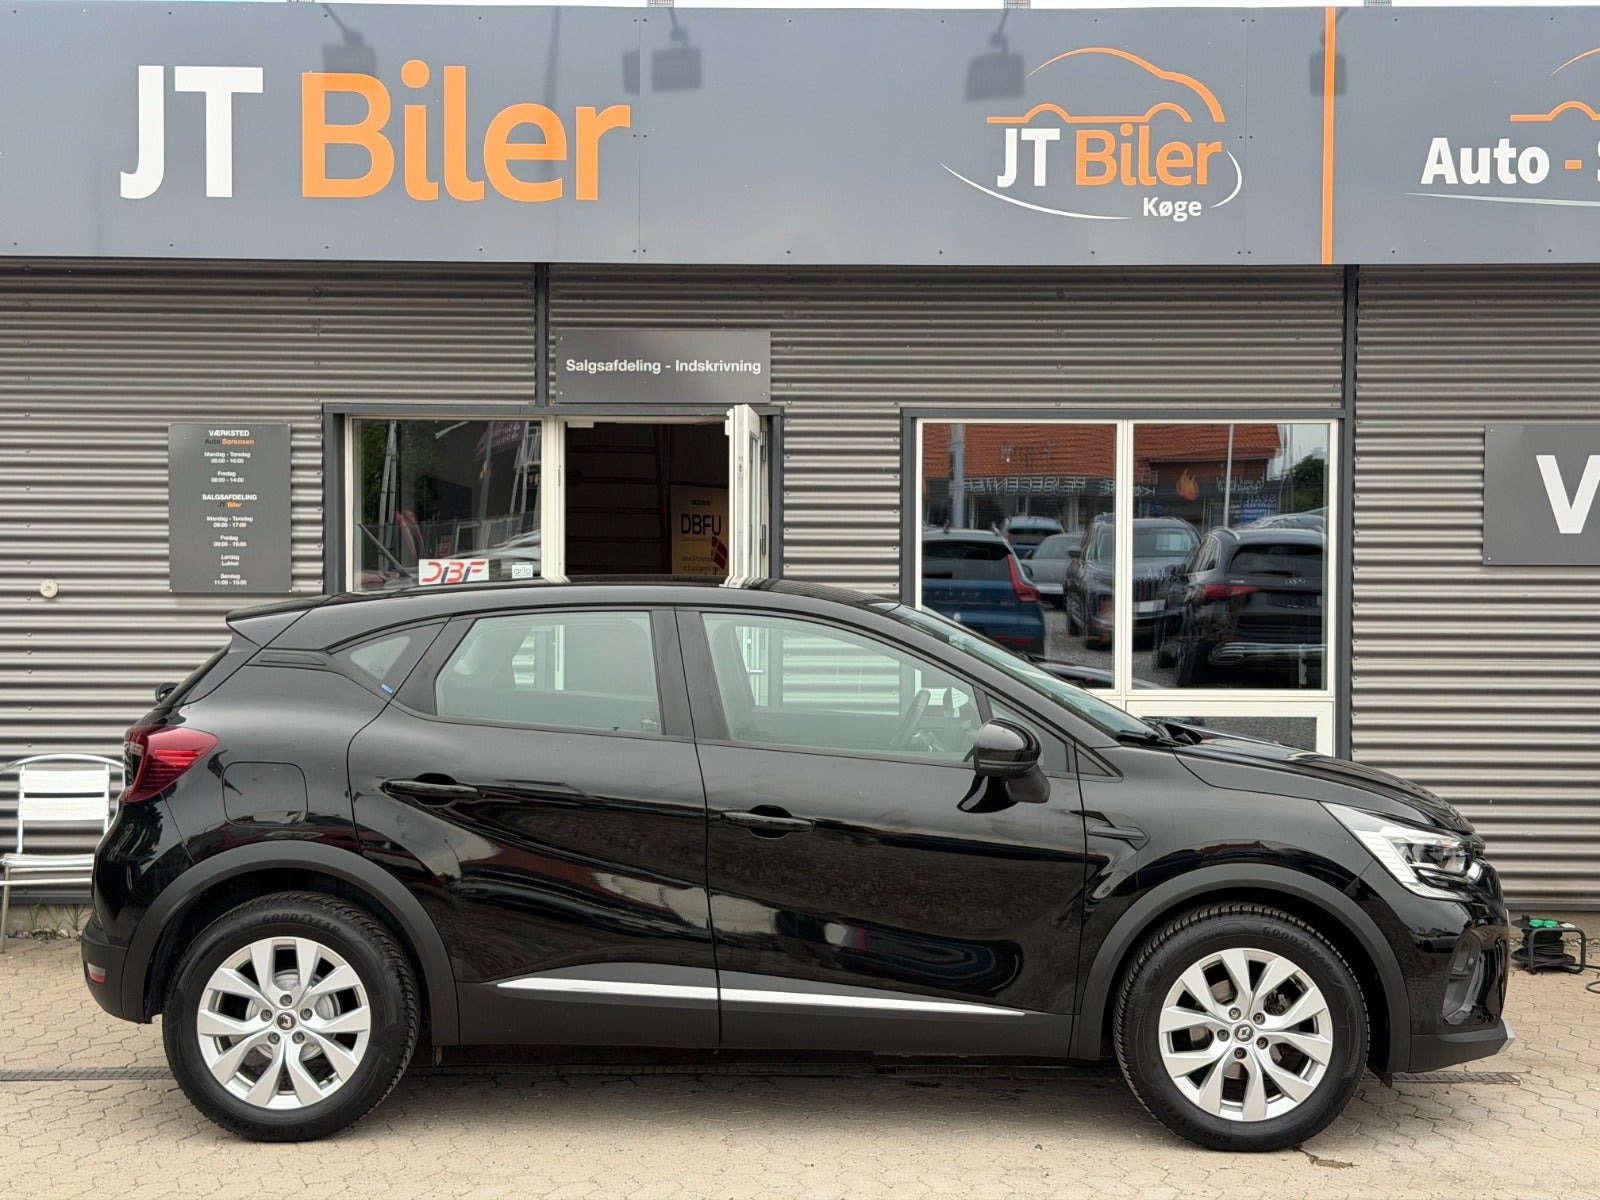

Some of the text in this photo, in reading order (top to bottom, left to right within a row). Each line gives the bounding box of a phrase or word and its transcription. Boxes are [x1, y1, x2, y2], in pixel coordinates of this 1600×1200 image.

[120, 59, 631, 202] JT Biler
[996, 123, 1222, 188] JT Biler
[1420, 137, 1550, 185] Auto
[1143, 197, 1202, 222] Køge
[566, 359, 661, 374] Salgsafdeling
[675, 359, 761, 374] Indskrivning
[208, 429, 250, 437] VÆRKSTED
[202, 493, 257, 501] SALGSAFDELING
[232, 515, 253, 523] Torsdag
[681, 513, 722, 536] DBFU
[262, 912, 341, 934] GOODYEAR
